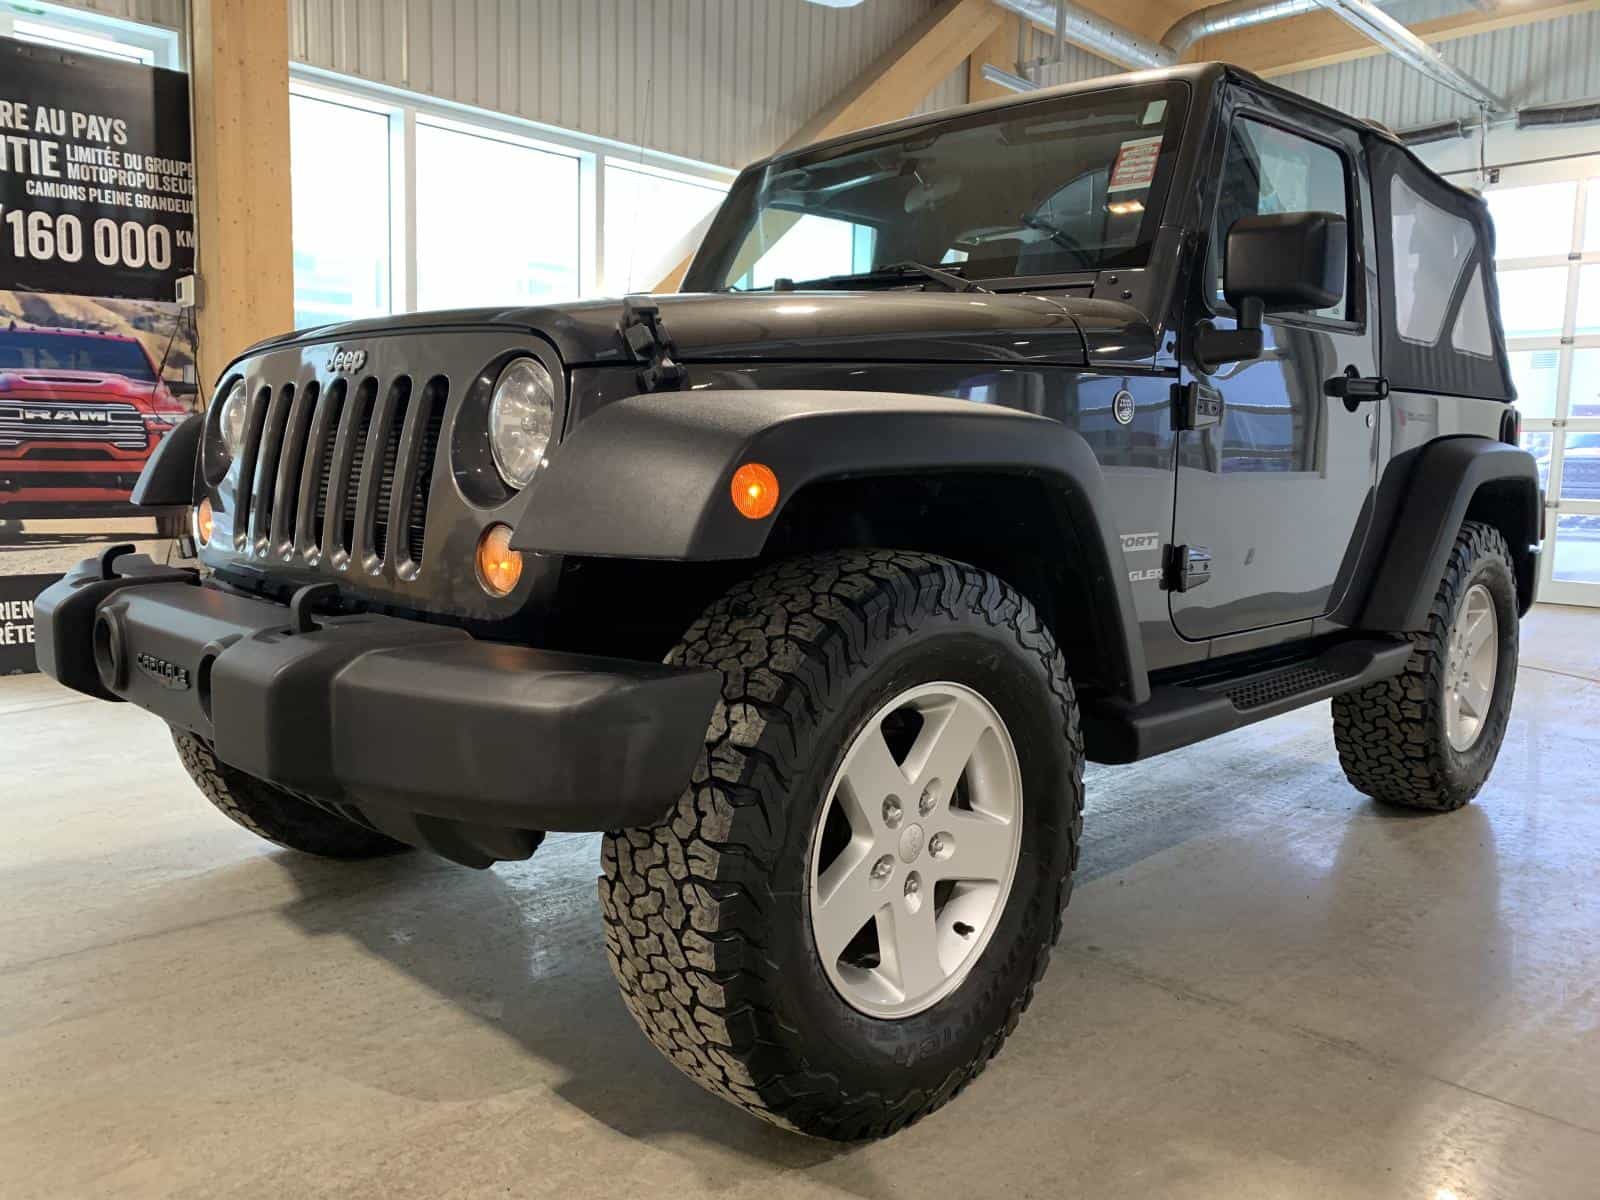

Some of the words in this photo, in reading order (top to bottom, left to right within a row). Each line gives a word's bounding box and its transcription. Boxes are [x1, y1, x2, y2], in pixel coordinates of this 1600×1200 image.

[35, 106, 66, 136] AU
[72, 111, 127, 145] PAYS
[66, 143, 120, 168] LIMITÉE
[124, 152, 142, 171] DU
[26, 180, 86, 201] CAMIONS
[89, 190, 133, 208] PLEINE
[94, 218, 171, 271] 000
[326, 346, 367, 375] Jeep
[24, 408, 107, 422] RAM
